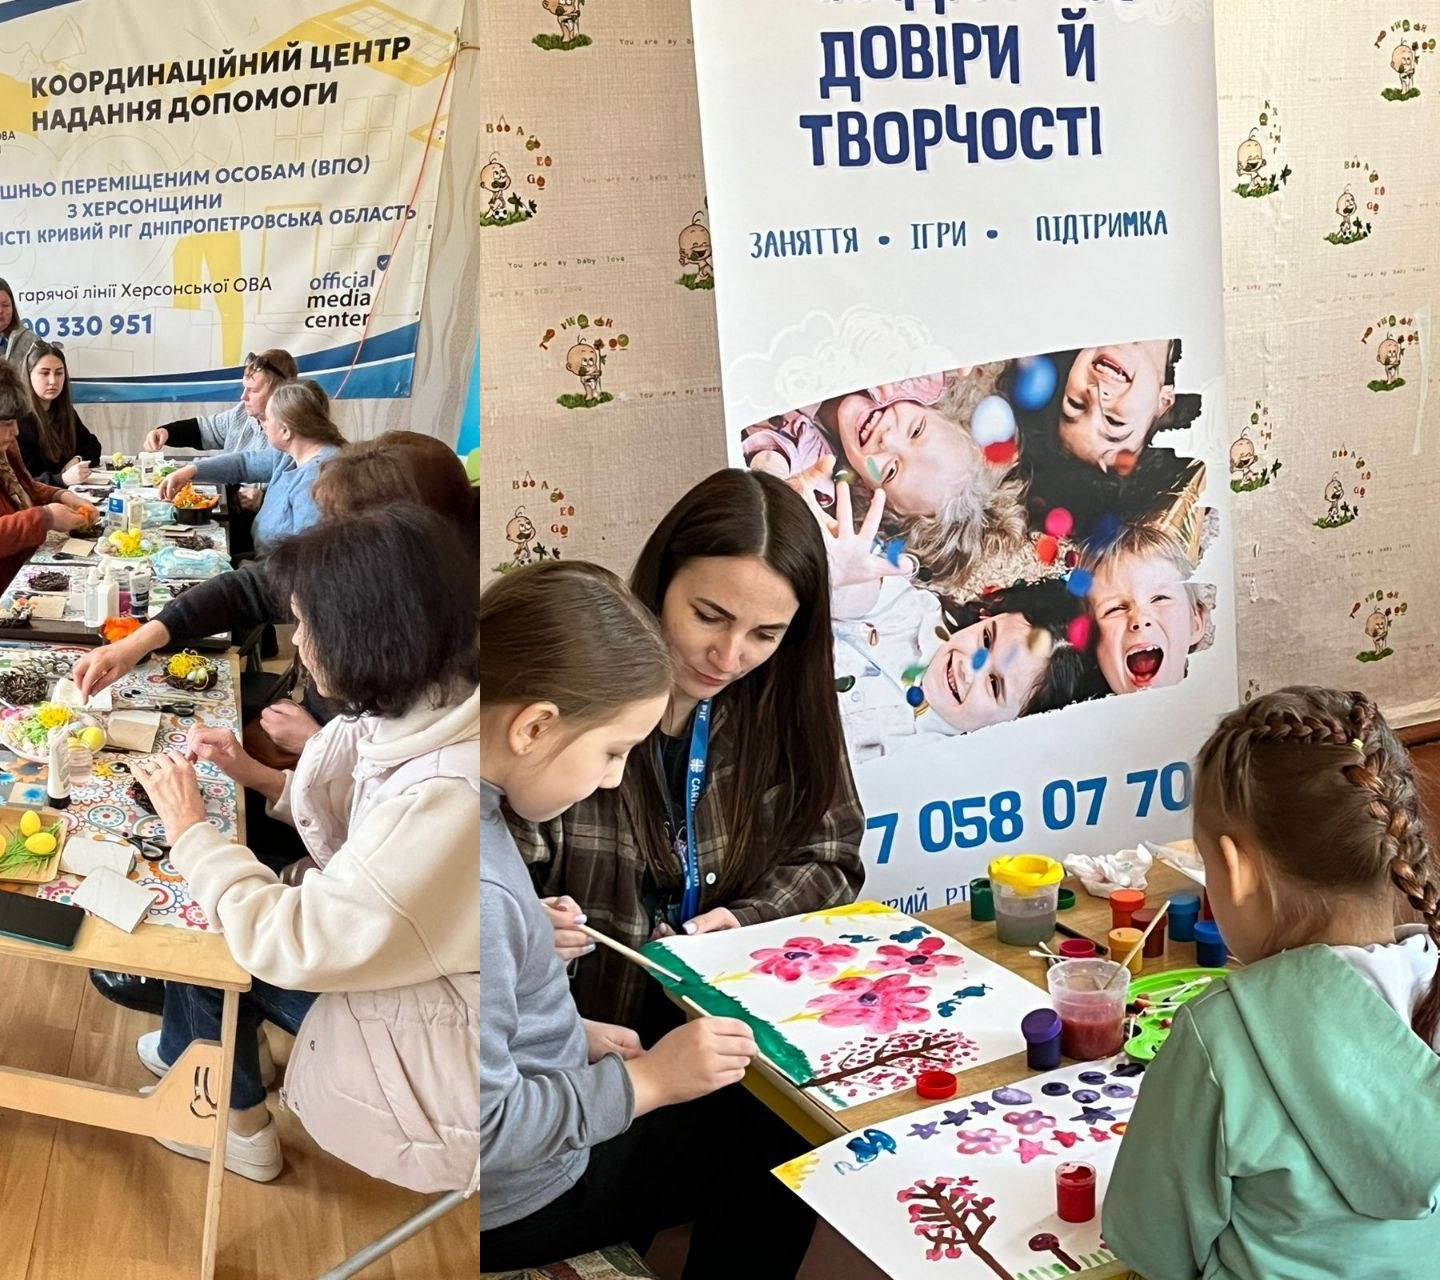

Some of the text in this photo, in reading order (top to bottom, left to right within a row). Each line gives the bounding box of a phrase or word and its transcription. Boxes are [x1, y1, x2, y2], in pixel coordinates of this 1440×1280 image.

[31, 36, 411, 98] КООРДИНАЦІЙНИЙ ЦЕНТР
[819, 7, 1095, 102] ДОВІРИ Й
[32, 81, 338, 133] НАДАННЯ ДОПОМОГИ
[799, 104, 1102, 171] ТВОРЧОСТІ
[61, 169, 210, 196] ПЕРЕМІЩЕНИМ
[215, 162, 305, 184] ОСОБАМ
[311, 155, 371, 178] (ВПО)
[37, 222, 103, 244] КРИВИЙ
[109, 224, 133, 239] РІГ
[138, 210, 323, 240] ДНІПРОПЕТРОВСЬКА
[329, 205, 417, 224] ОБЛАСТЬ
[82, 193, 222, 218] ХЕРСОНЩИНИ
[749, 209, 1168, 259] ЗАНЯТТЯ ІГРИ ПІДТРИМКА
[19, 286, 78, 305] гарячої
[83, 283, 117, 300] лінії
[121, 278, 229, 300] Херсонської
[233, 277, 272, 293] ОВА
[306, 289, 371, 309] media
[310, 270, 375, 290] official
[56, 315, 103, 337] 330
[110, 314, 152, 335] 951
[305, 312, 370, 329] center
[919, 790, 1024, 853] 058
[1042, 776, 1108, 830] 07
[1126, 762, 1192, 818] 70
